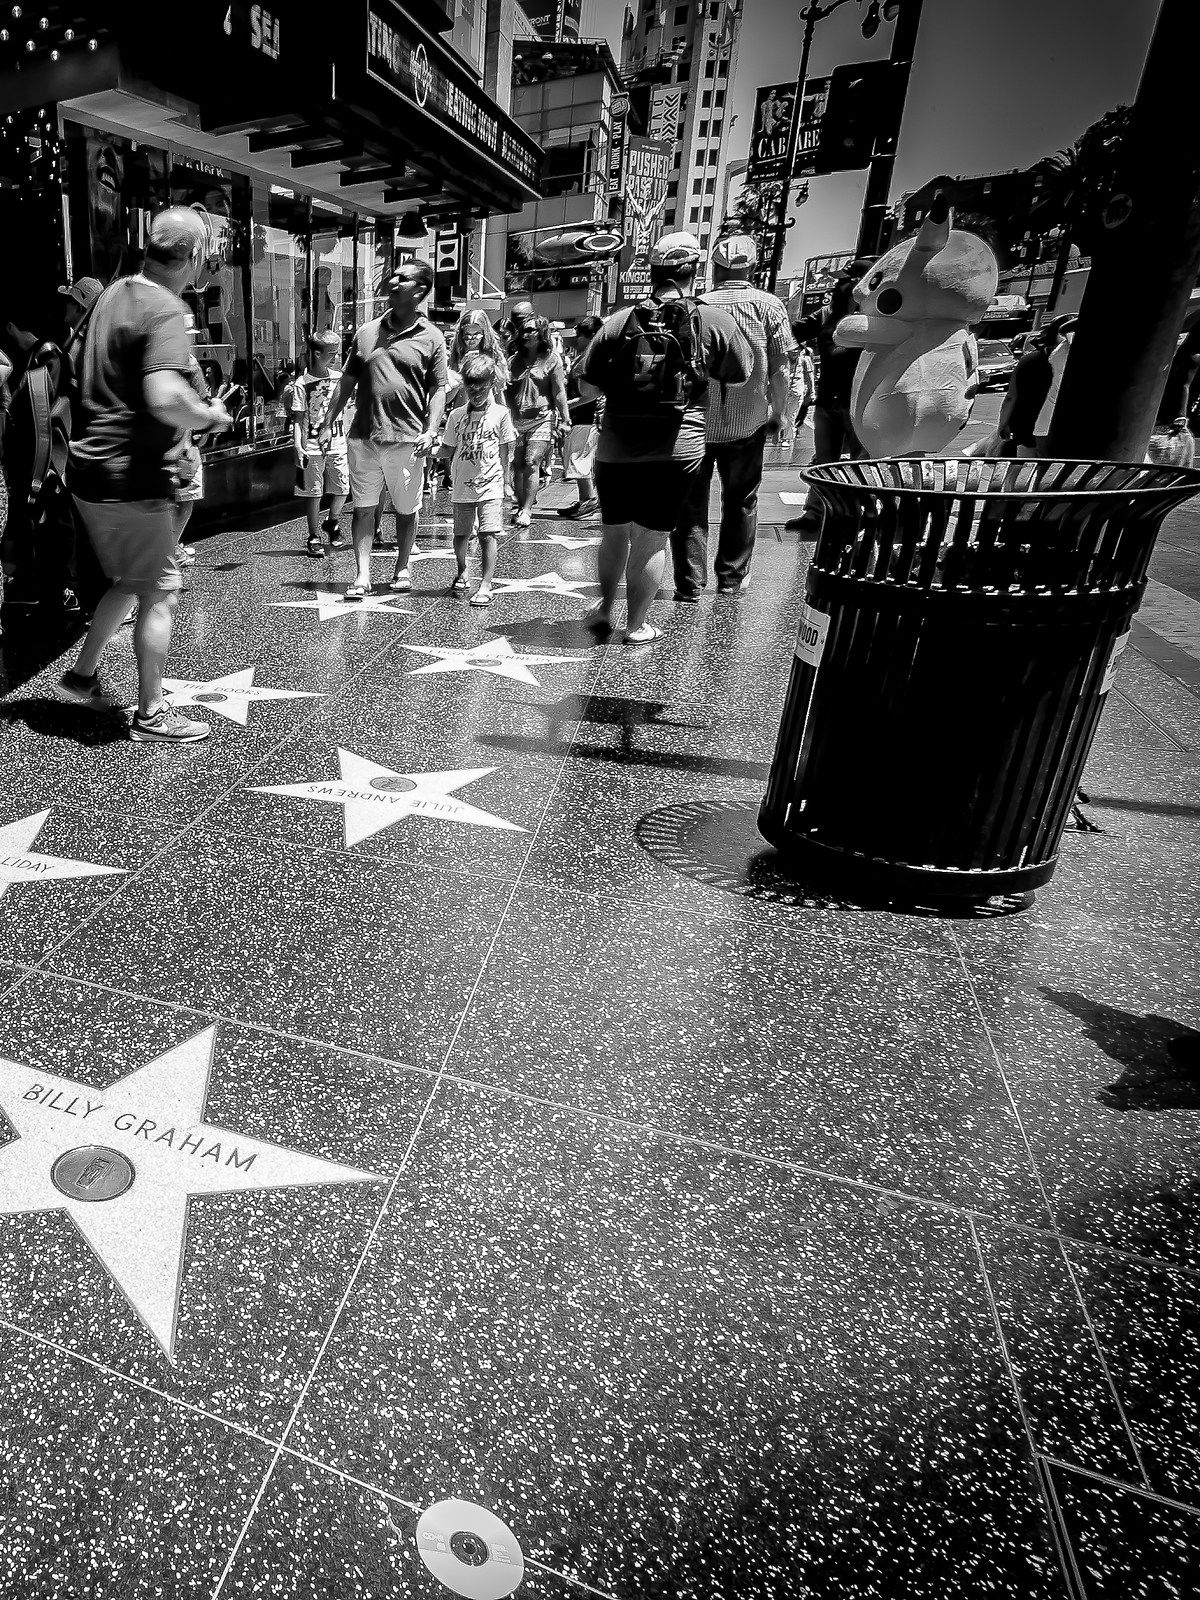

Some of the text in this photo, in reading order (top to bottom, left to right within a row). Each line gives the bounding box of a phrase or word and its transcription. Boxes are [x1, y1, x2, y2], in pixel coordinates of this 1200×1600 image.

[758, 128, 821, 158] CABARE
[629, 150, 669, 180] PUSHED
[571, 274, 608, 283] OAKL
[799, 622, 818, 646] OOD
[307, 785, 465, 813] JULIE ANDREWS
[22, 1083, 259, 1172] BILLY GRAHAM
